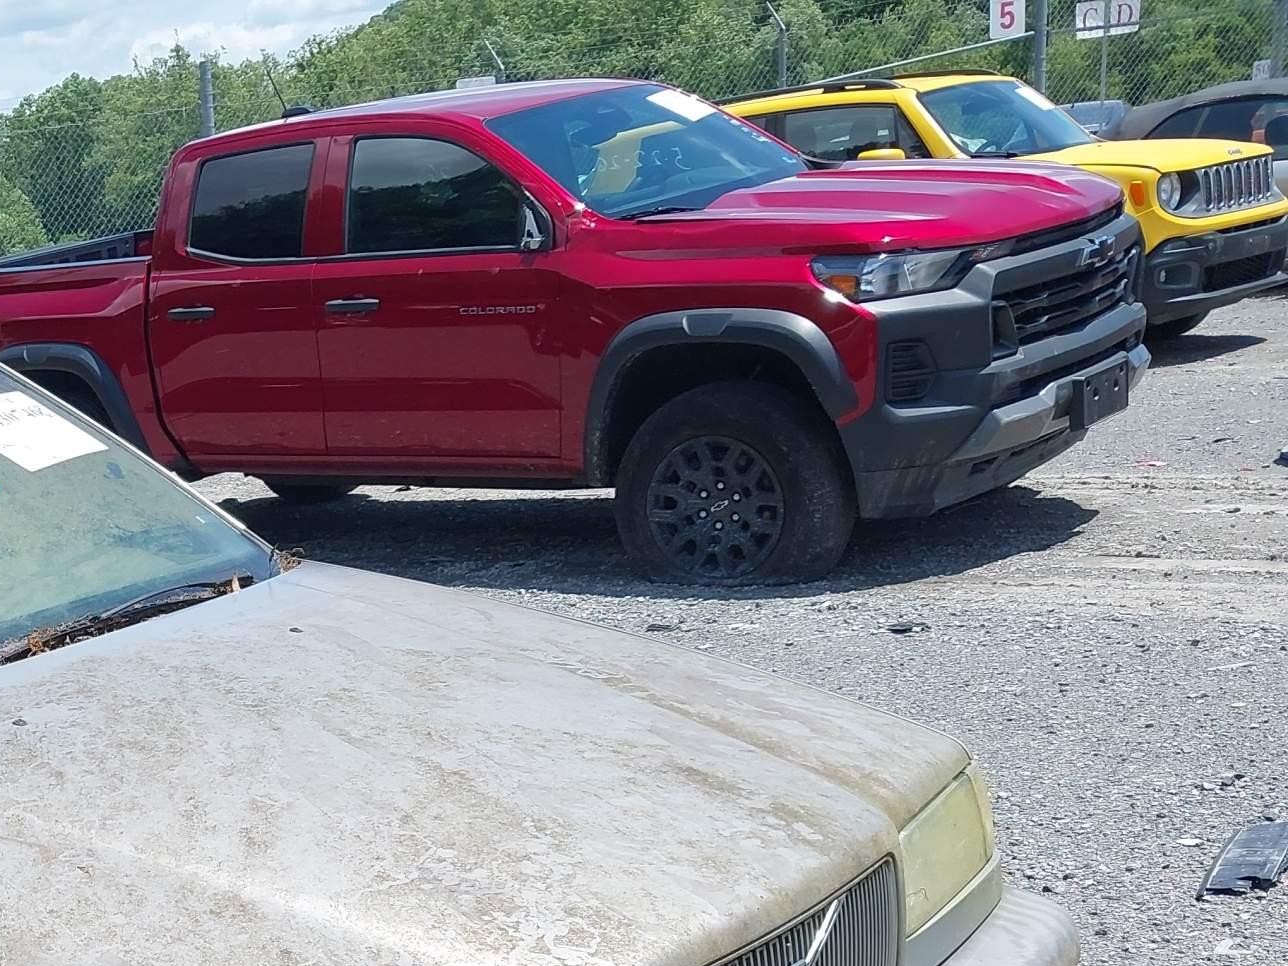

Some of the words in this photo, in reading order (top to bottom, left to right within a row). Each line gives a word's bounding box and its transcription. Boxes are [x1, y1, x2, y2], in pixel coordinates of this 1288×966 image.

[999, 1, 1015, 29] 5
[1083, 7, 1098, 28] C
[1117, 3, 1133, 25] D
[459, 305, 536, 315] COLORADO
